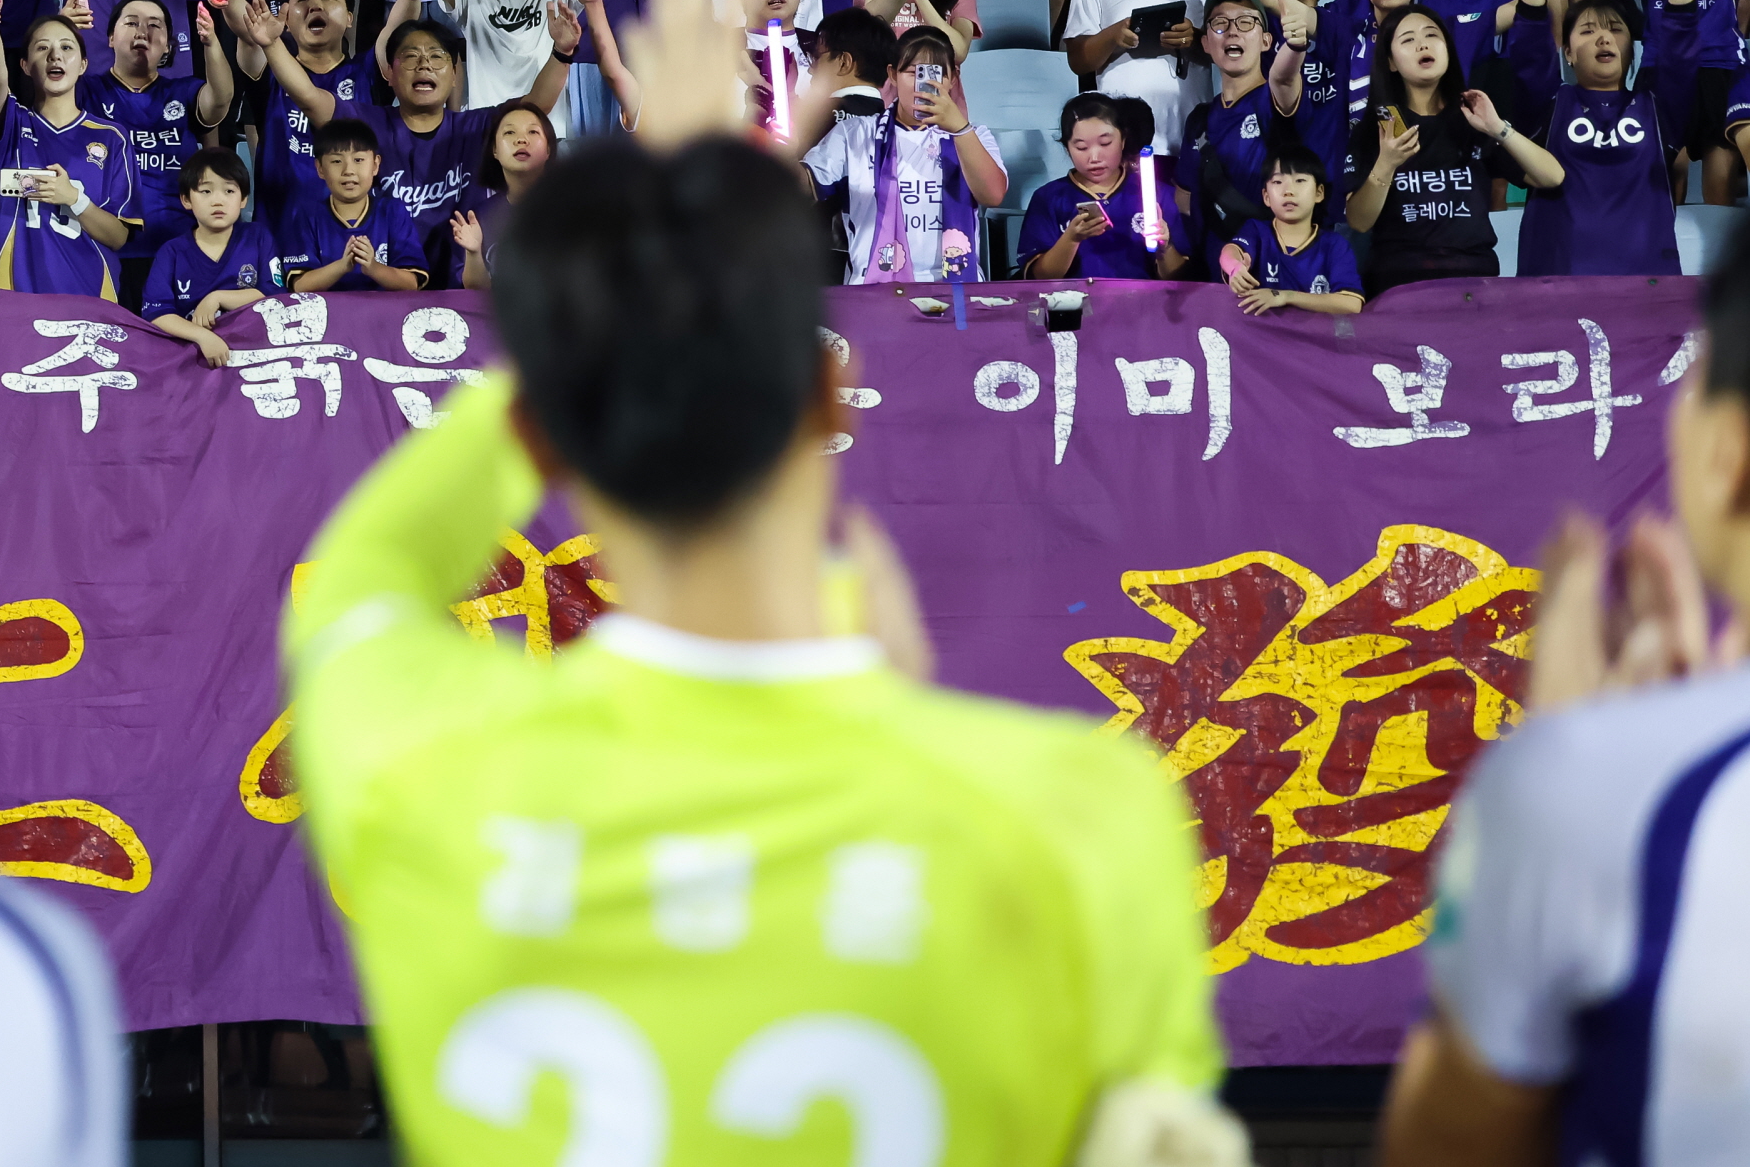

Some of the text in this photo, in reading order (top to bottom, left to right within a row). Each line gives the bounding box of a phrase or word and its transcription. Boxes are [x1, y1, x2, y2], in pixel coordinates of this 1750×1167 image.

[497, 6, 536, 20] NIKE
[130, 128, 181, 149] 링턴
[1567, 117, 1645, 148] OHC
[380, 164, 471, 217] Anyang
[898, 180, 943, 206] 링턴
[1395, 166, 1473, 195] 해링턴
[1402, 200, 1471, 223] 플레이스
[222, 291, 490, 431] 붉은
[973, 325, 1232, 465] 이미
